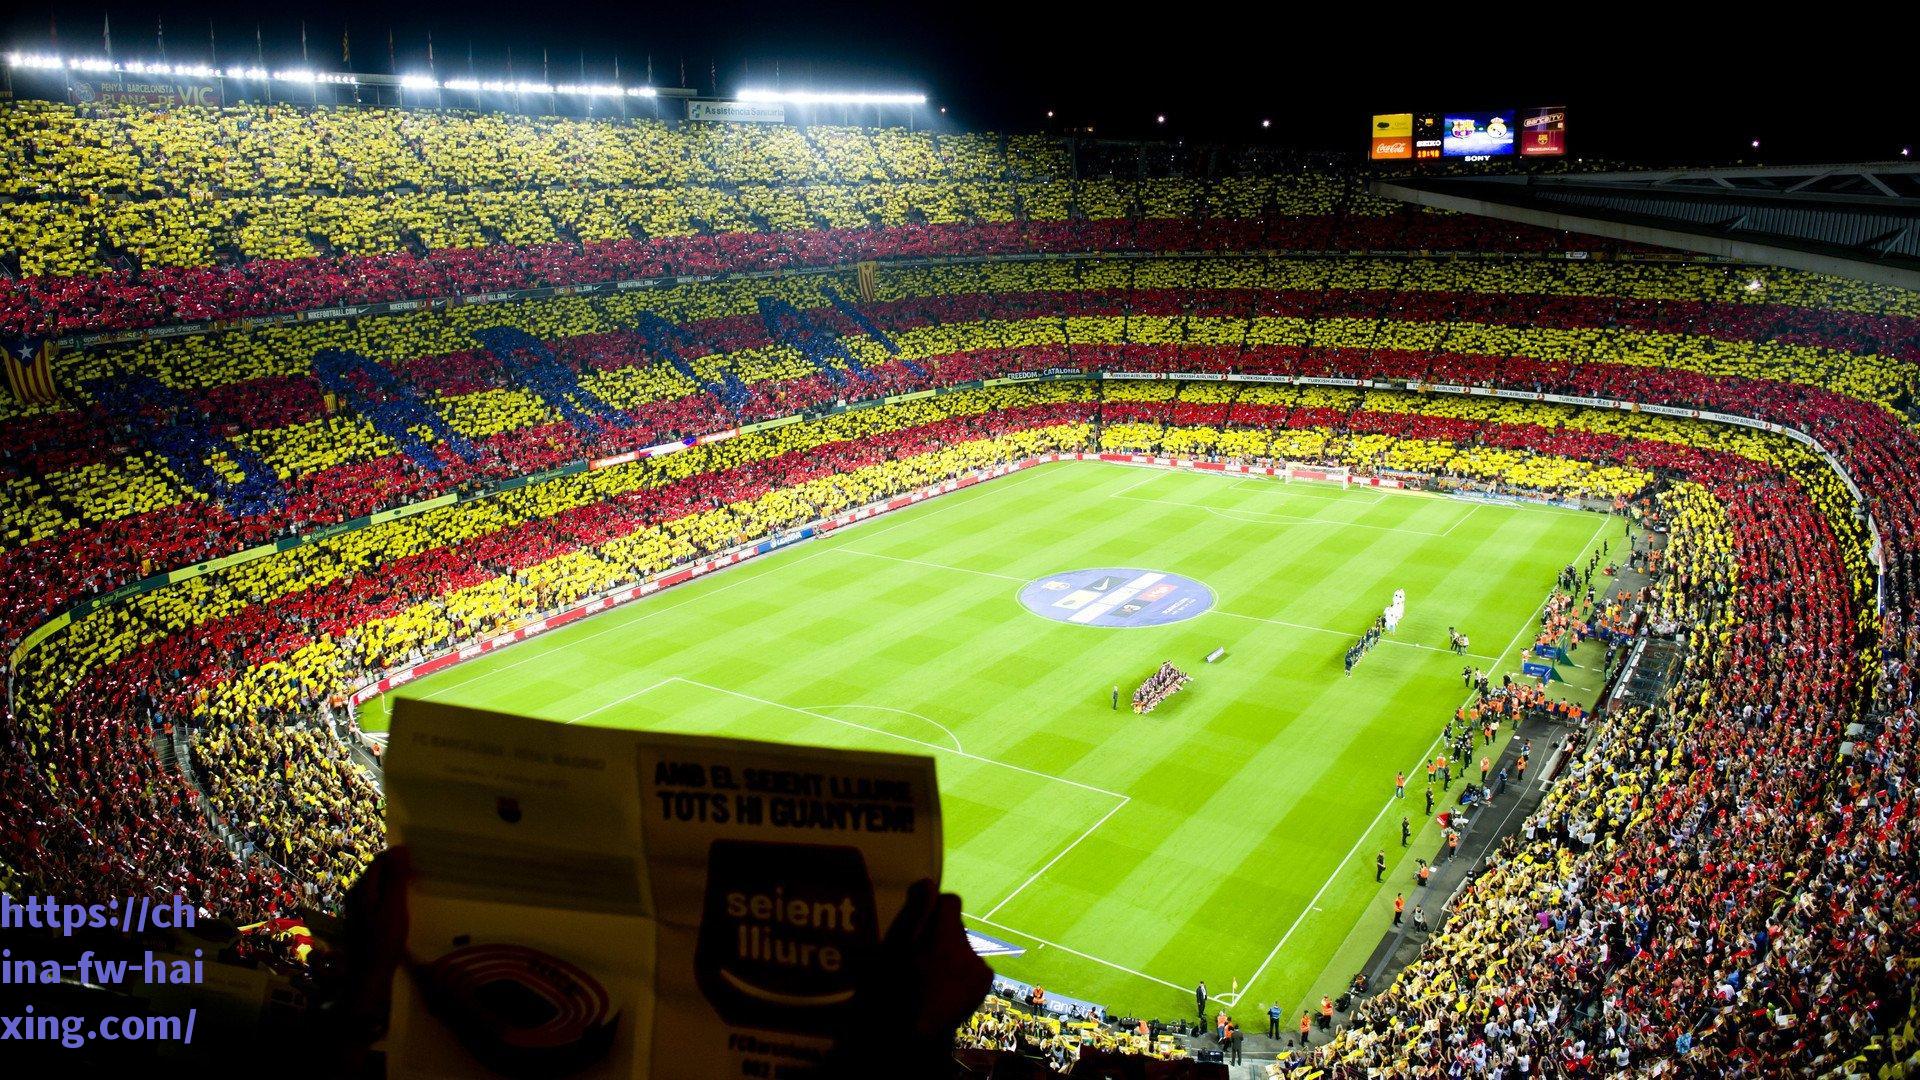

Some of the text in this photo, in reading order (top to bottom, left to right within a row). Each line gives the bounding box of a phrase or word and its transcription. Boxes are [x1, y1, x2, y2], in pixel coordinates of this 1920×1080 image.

[101, 83, 123, 92] PENYA
[103, 93, 175, 106] PLANA DE
[177, 84, 214, 106] VIC
[307, 307, 357, 320] NIKEFOOTBALL.COM
[1007, 371, 1038, 380] FREEDOM
[1043, 368, 1080, 376] CATALONIA
[1558, 396, 1583, 404] TURKISH
[1661, 407, 1688, 415] AIRLINES
[1714, 414, 1763, 427] TURKISH AIRLINES
[655, 761, 706, 787] AMB
[711, 765, 739, 790] EL
[743, 768, 823, 798] SEIENT
[657, 791, 730, 823] TOTS
[736, 795, 763, 825] HI
[725, 883, 857, 933] seient
[737, 923, 844, 973] lliure
